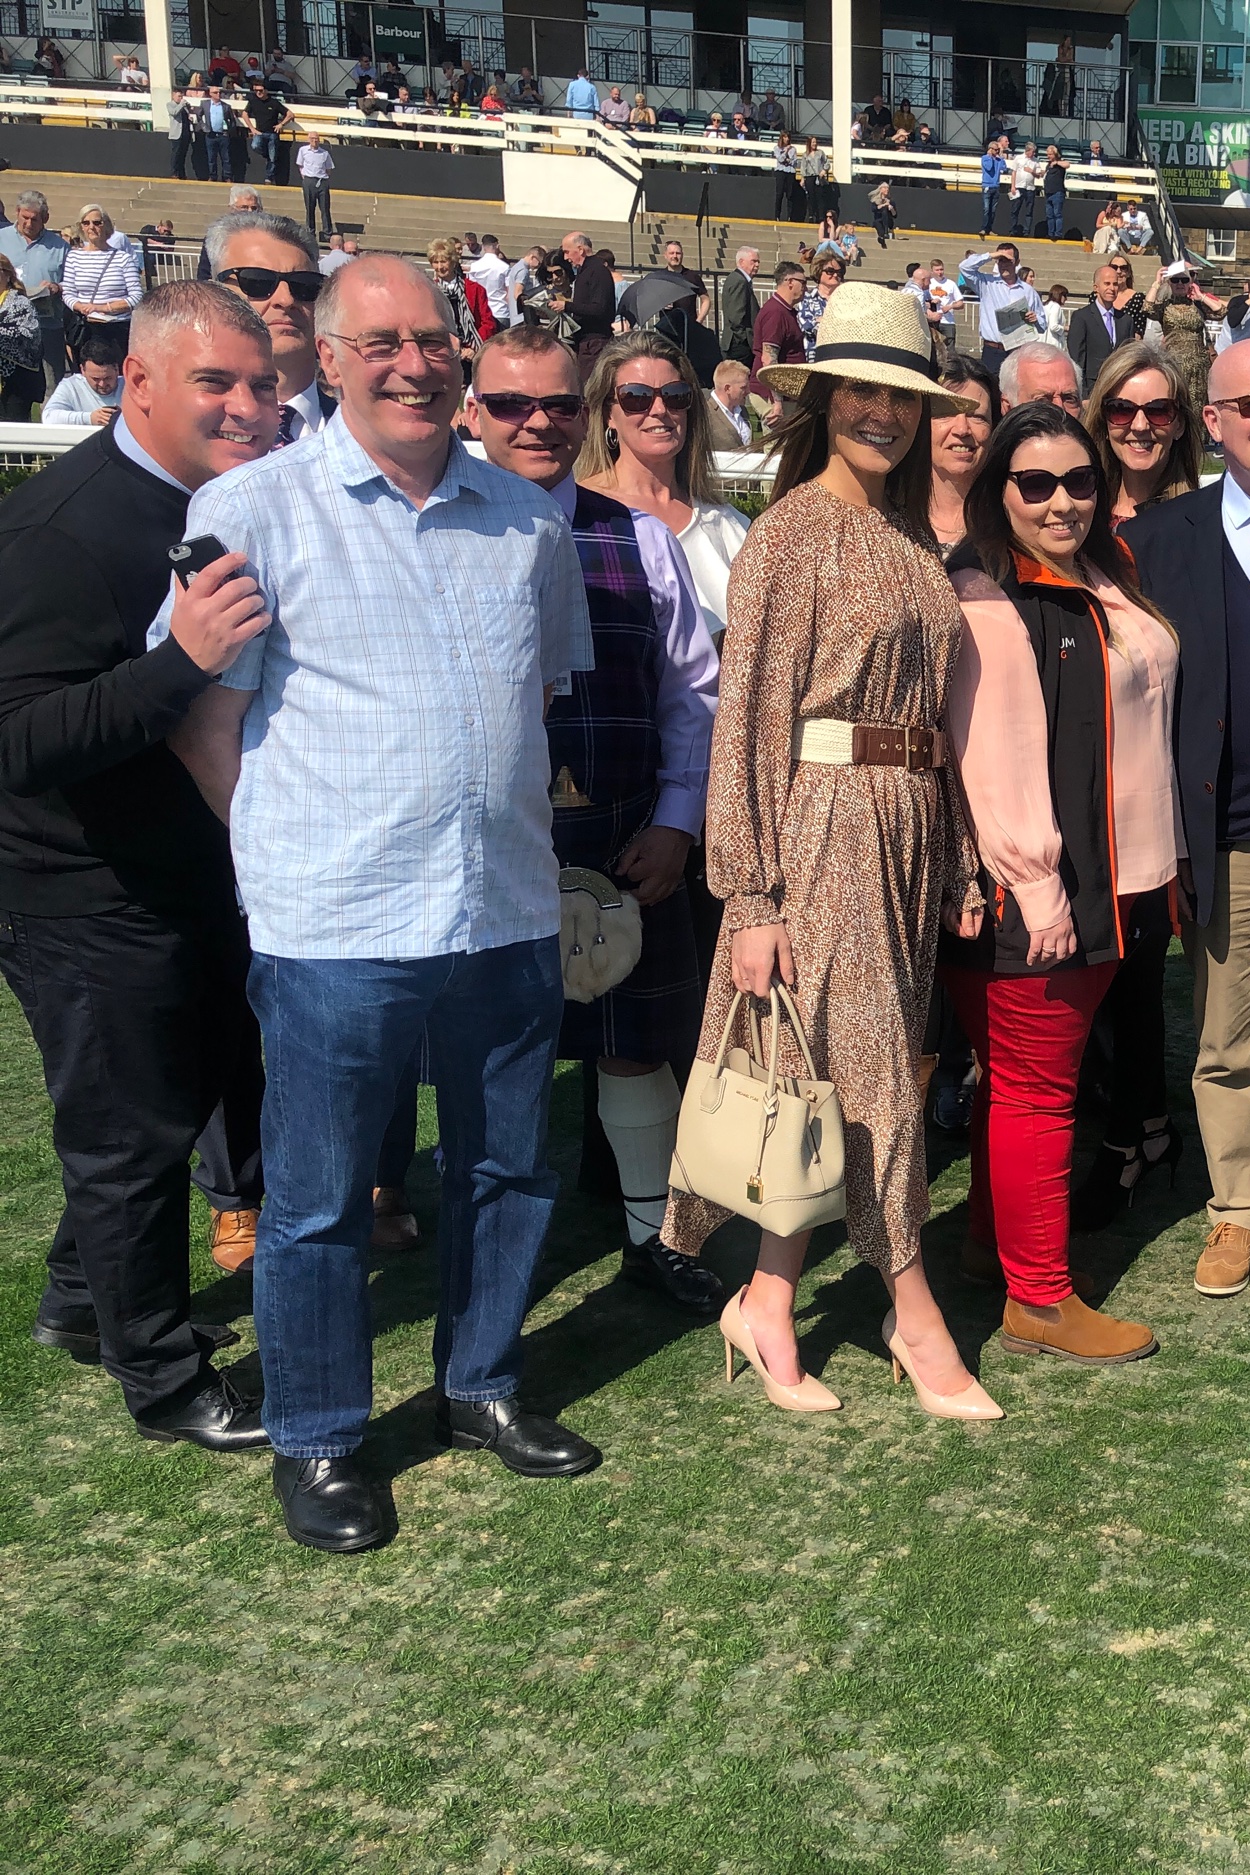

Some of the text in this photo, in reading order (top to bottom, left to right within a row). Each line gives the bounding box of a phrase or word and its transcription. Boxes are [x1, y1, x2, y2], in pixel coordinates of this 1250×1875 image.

[375, 25, 421, 38] Barbour
[1190, 121, 1204, 143] A
[1166, 143, 1180, 165] A
[1185, 144, 1230, 167] BIN?
[1160, 168, 1228, 180] ONEY WITH YOUR
[1187, 179, 1231, 189] RECYCLING
[1166, 187, 1188, 196] CTION
